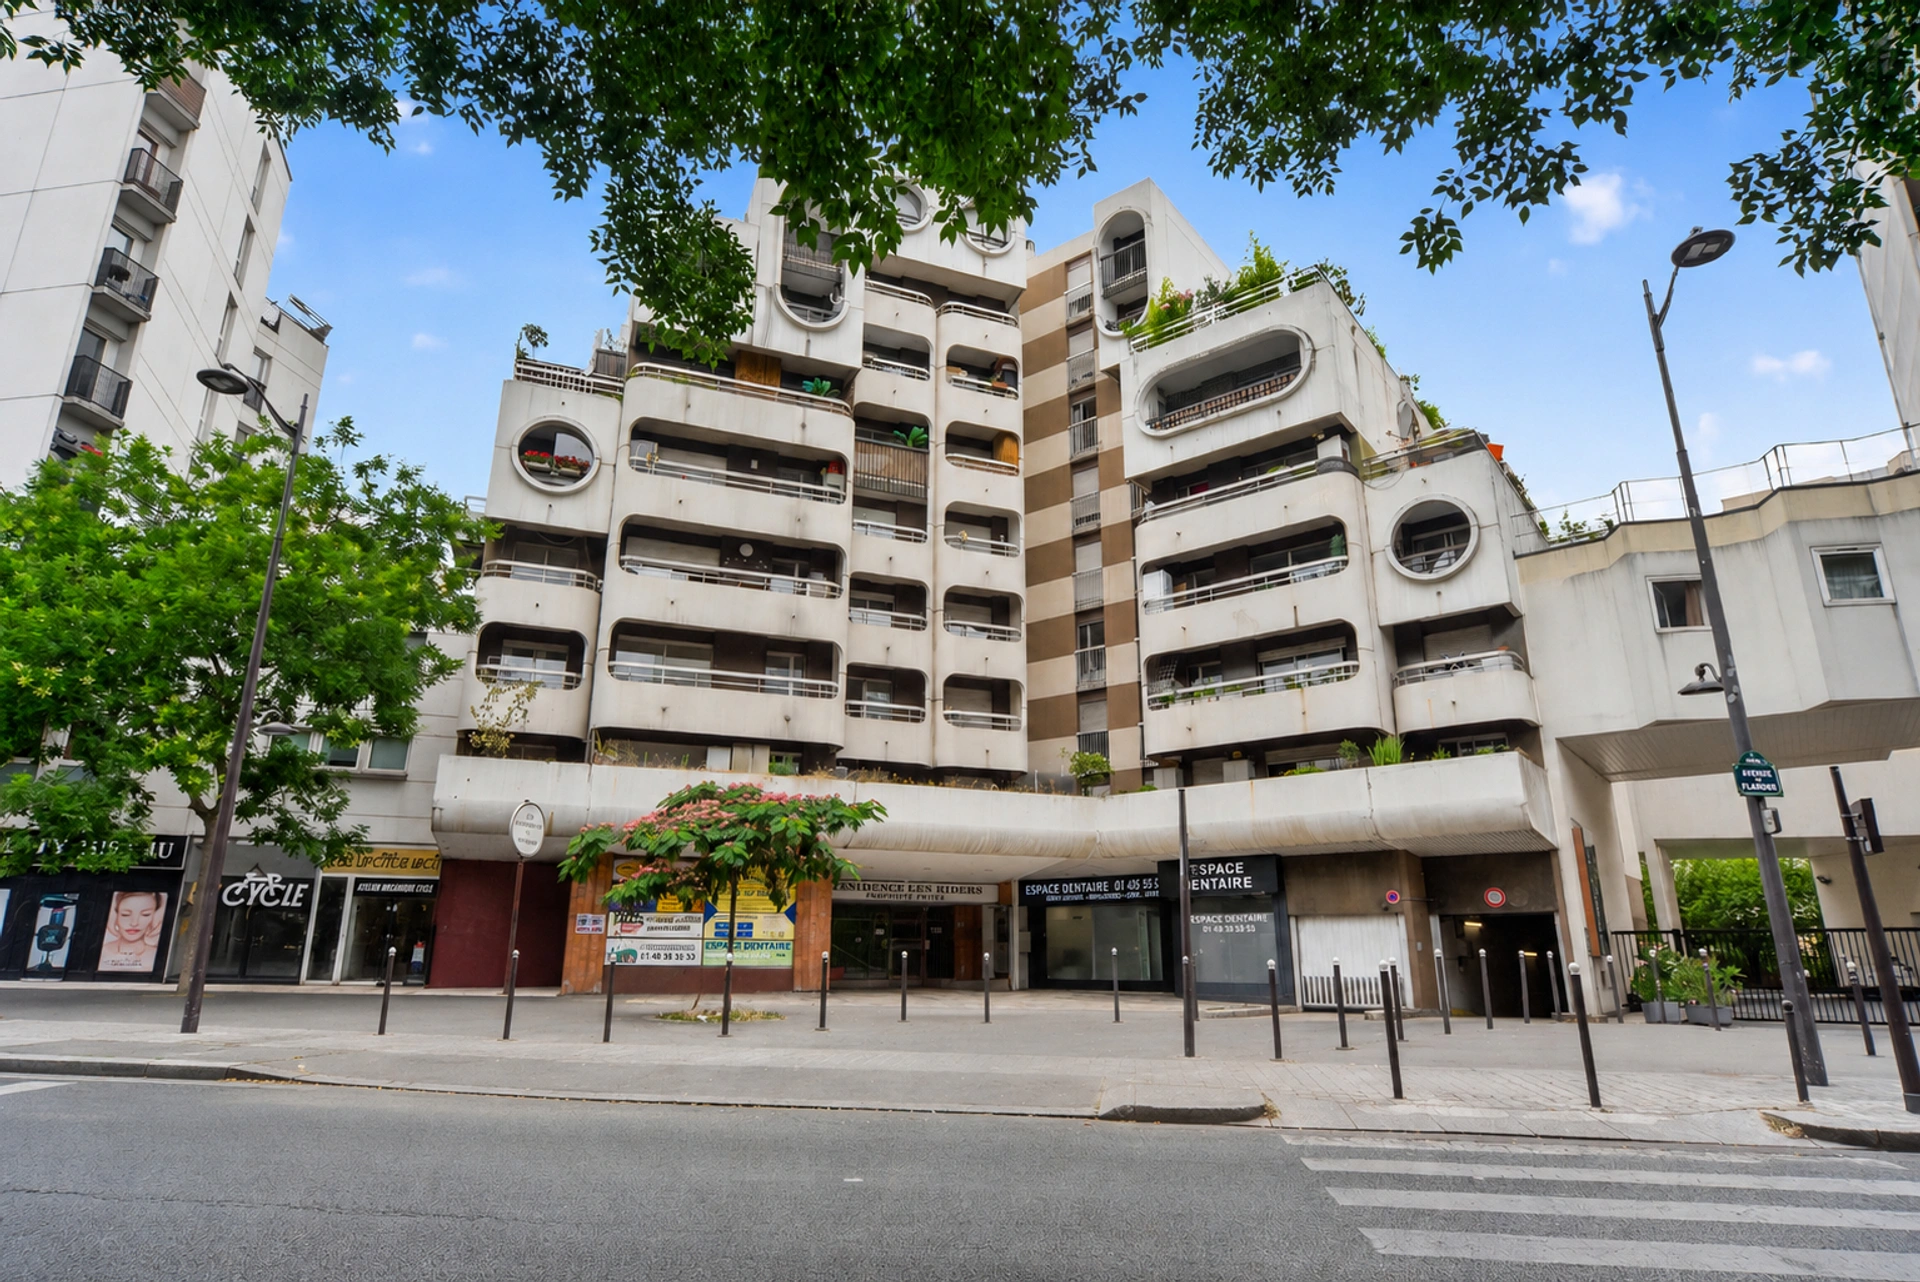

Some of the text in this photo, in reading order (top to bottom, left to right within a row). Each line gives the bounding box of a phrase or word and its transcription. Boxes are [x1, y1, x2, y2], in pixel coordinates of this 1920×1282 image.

[907, 884, 932, 894] LES
[936, 885, 983, 896] RIDERS
[1025, 883, 1060, 896] ESPACE
[1188, 876, 1253, 891] ENTAIRE
[222, 879, 309, 907] CYCLE
